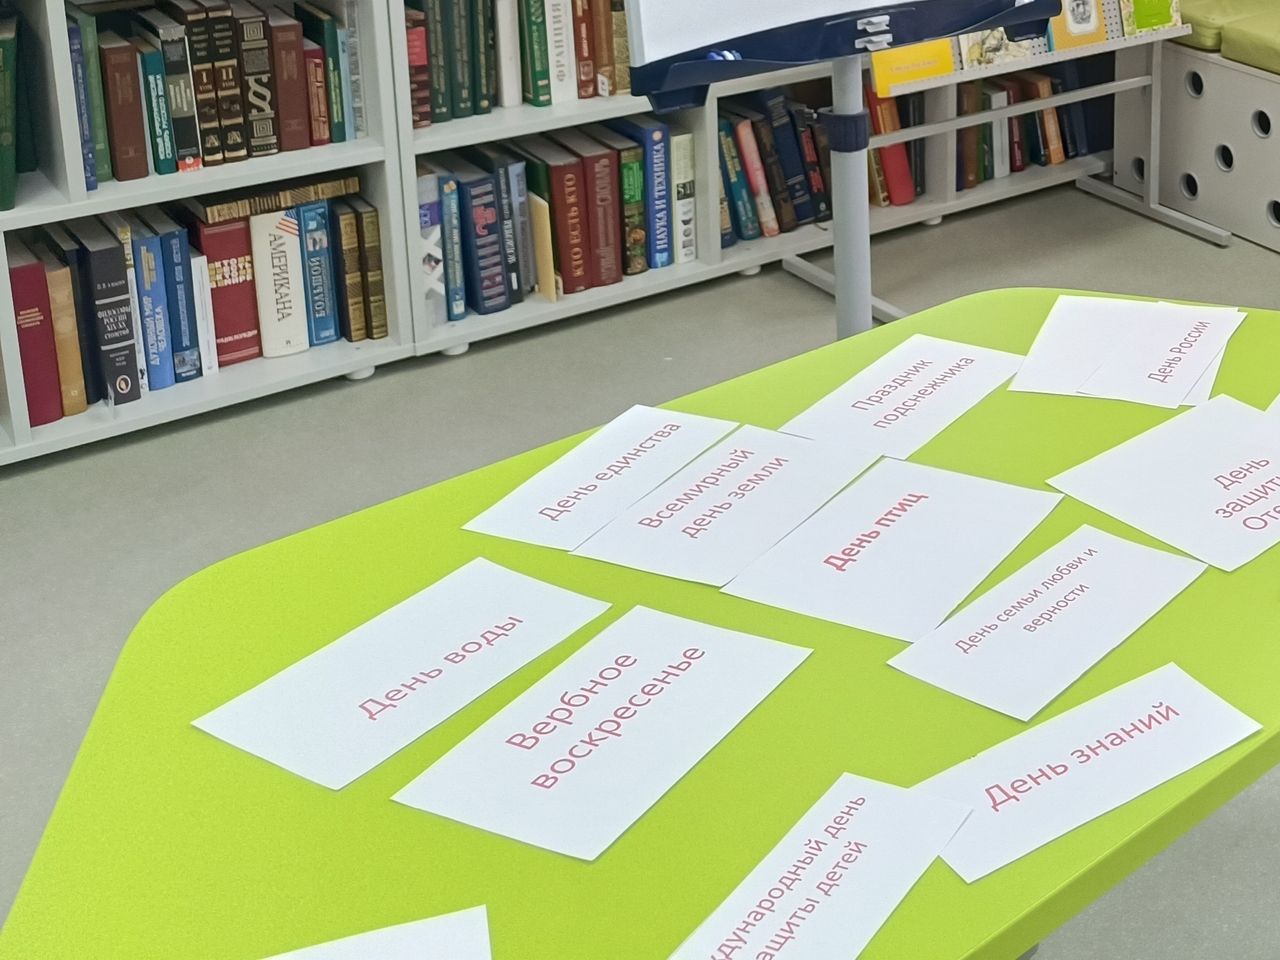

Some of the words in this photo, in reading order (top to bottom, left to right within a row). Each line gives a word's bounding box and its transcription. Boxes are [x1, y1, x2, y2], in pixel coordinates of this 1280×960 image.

[550, 2, 566, 82] ФРАНЦИЯ
[563, 172, 579, 204] КТО
[651, 142, 666, 197] ТЕХНИКА
[653, 199, 666, 209] И
[566, 207, 582, 245] ЕСТЬ
[568, 247, 585, 278] КТО
[654, 210, 668, 250] НАУКА
[269, 233, 293, 323] АМЕРИКАНА
[309, 256, 326, 318] БОЛЬШОЙ
[851, 359, 933, 412] Праздник
[1147, 356, 1181, 384] День
[1170, 320, 1211, 359] России
[873, 356, 976, 429] подснежника
[538, 481, 598, 522] День
[595, 423, 682, 482] единства
[638, 449, 755, 528] Всемирный
[682, 502, 733, 539] день
[728, 456, 790, 500] земли
[1214, 457, 1271, 491] День
[823, 526, 881, 573] День
[876, 491, 929, 529] птиц
[955, 622, 999, 655] День
[996, 588, 1043, 623] семьи
[1041, 557, 1087, 591] любви
[1083, 547, 1099, 559] и
[1023, 583, 1090, 633] верности
[358, 665, 444, 721] День
[443, 616, 524, 664] воды
[505, 653, 638, 751] Вербное
[530, 646, 706, 790] воскресенье
[984, 764, 1069, 812] День
[1070, 701, 1181, 764] знаний
[824, 796, 866, 839] день
[755, 897, 821, 960] ащиты
[815, 840, 869, 897] детей
